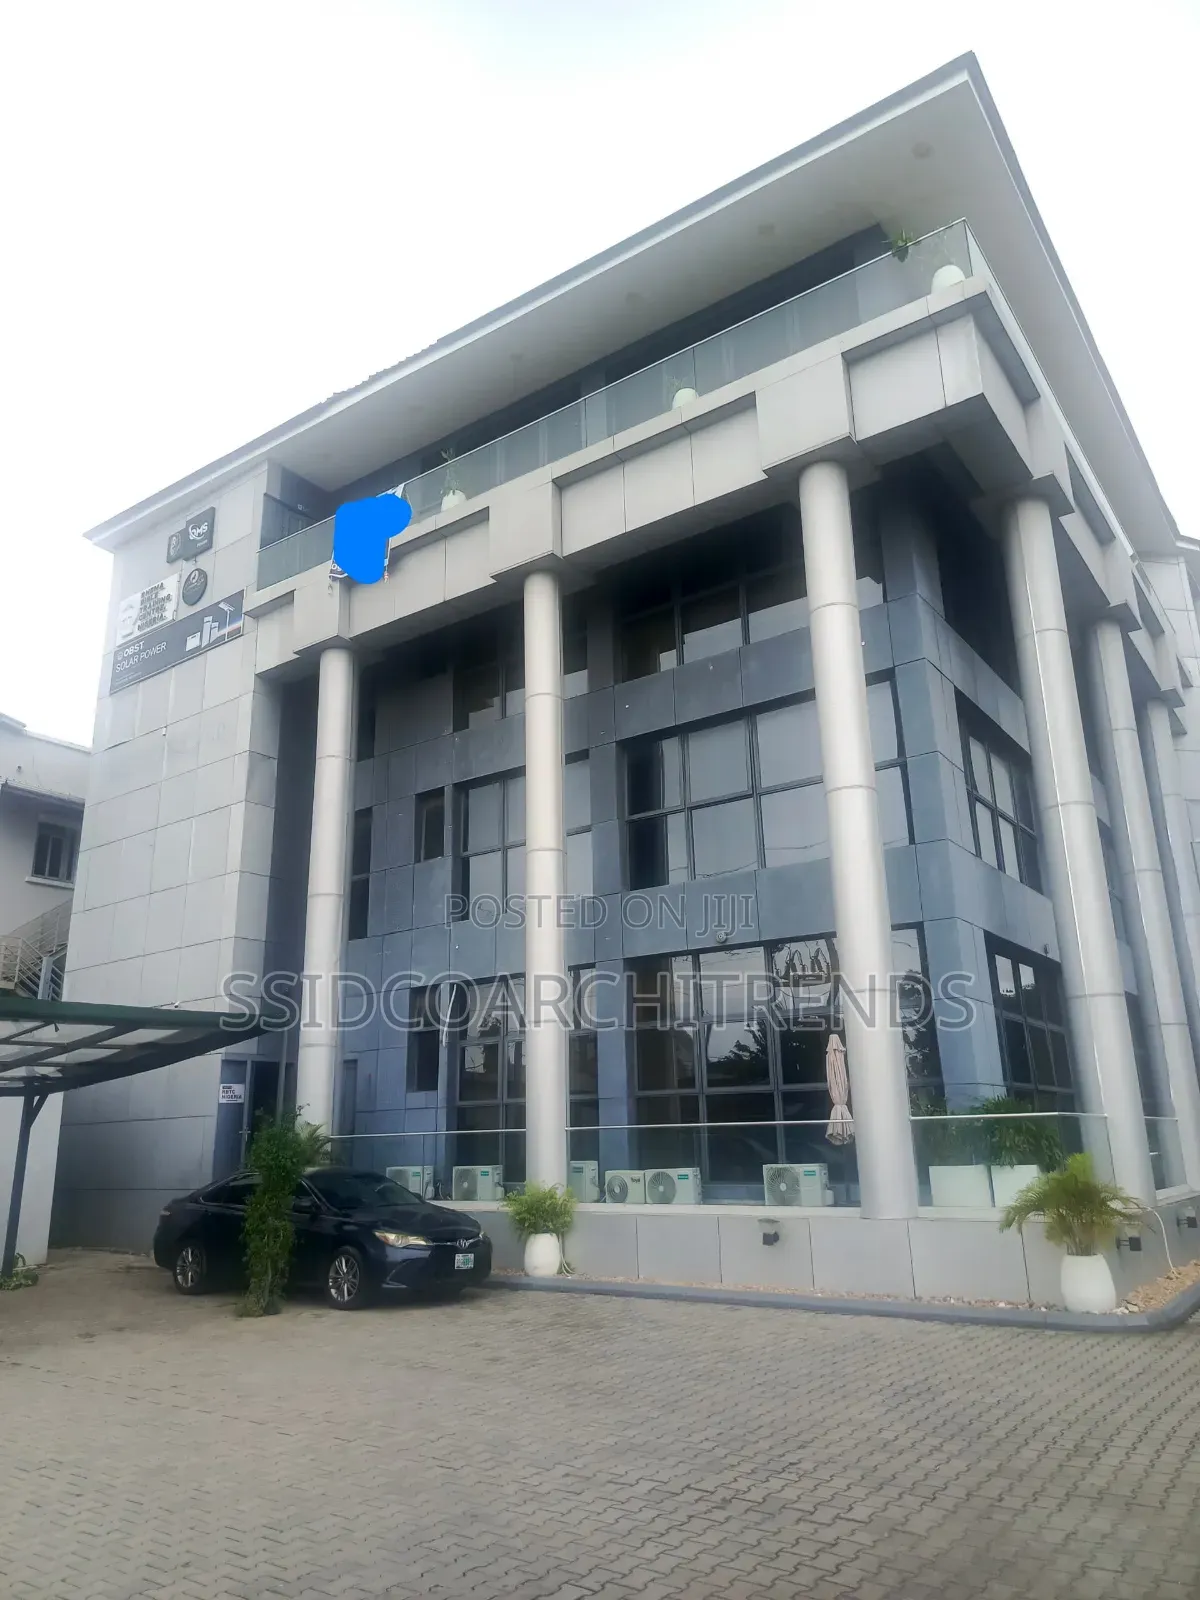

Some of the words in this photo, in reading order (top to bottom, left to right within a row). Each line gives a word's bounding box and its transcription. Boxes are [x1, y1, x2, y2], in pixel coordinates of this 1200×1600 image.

[115, 655, 139, 672] SOLAR
[140, 642, 167, 661] POWER
[123, 640, 145, 657] OBST
